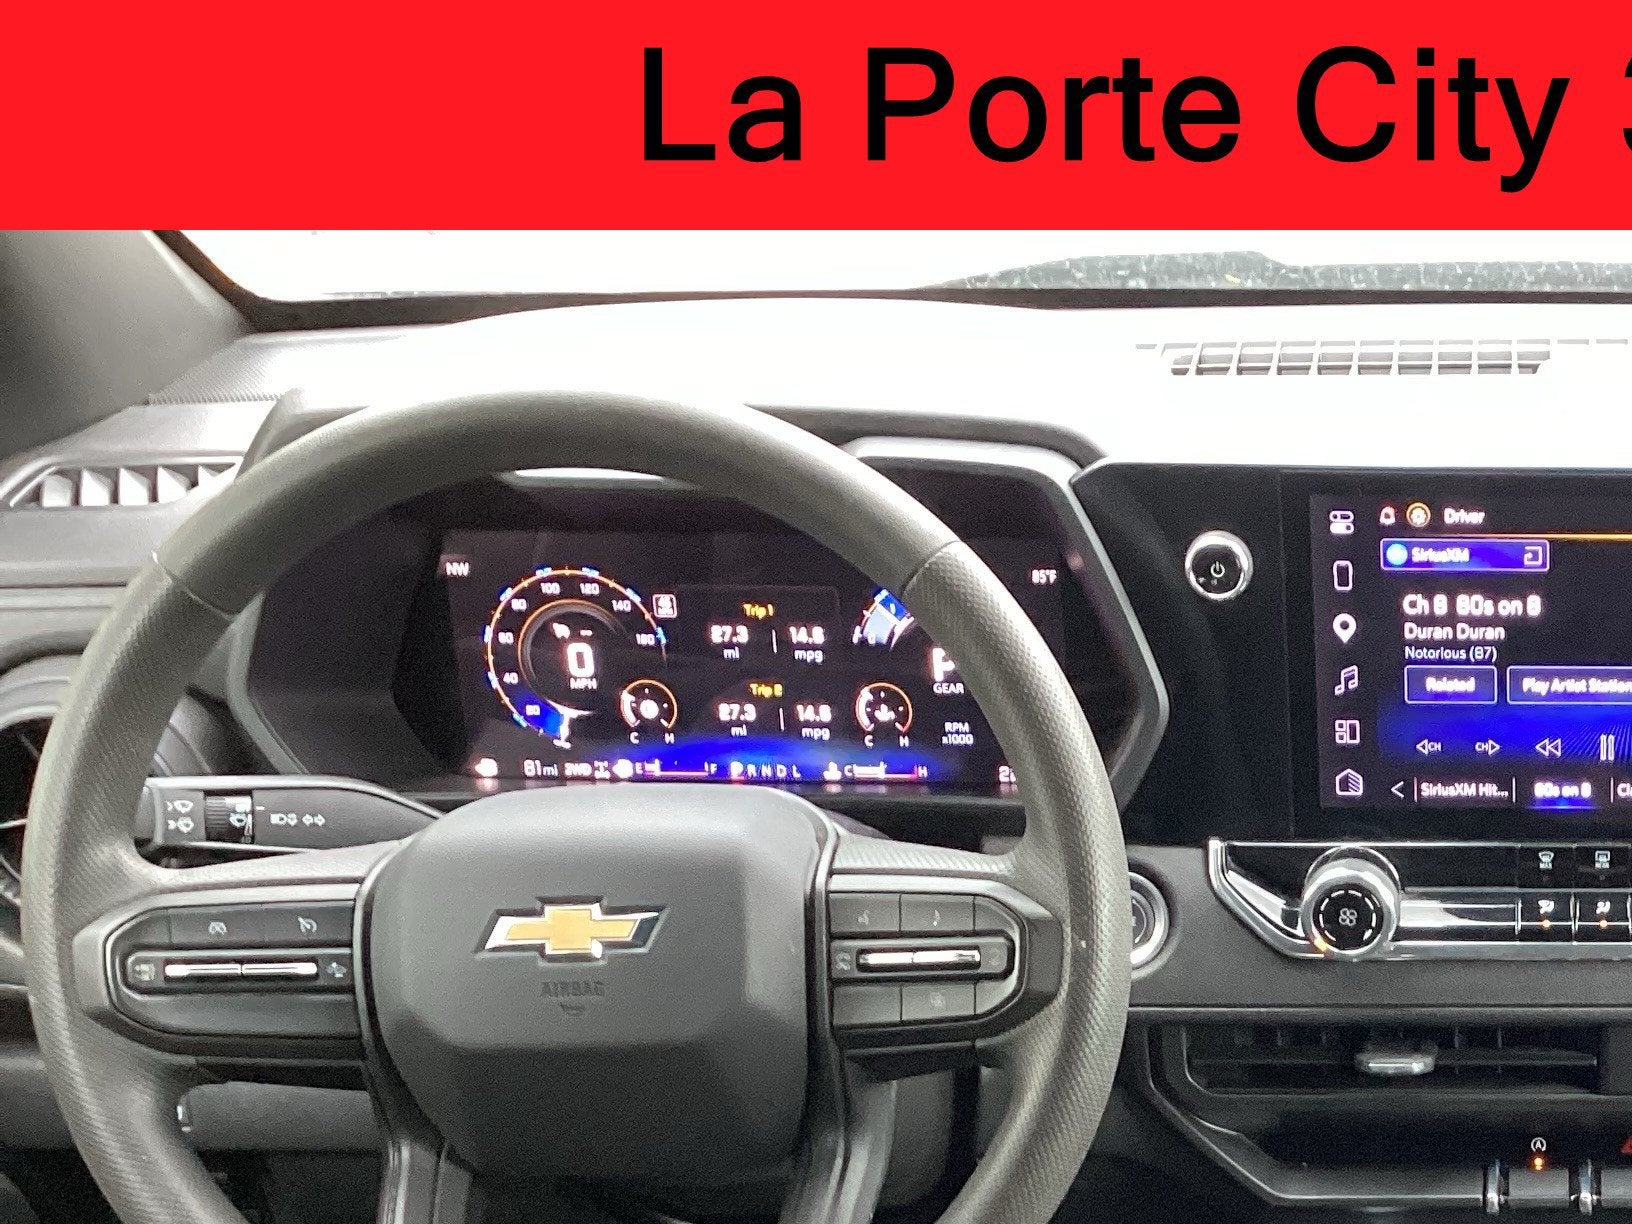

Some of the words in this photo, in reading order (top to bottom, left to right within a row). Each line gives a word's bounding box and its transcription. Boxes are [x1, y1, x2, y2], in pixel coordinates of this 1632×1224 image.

[1443, 507, 1486, 525] Driver
[446, 562, 470, 577] NW
[541, 582, 561, 595] 100
[580, 583, 600, 595] 120
[612, 599, 632, 613] 140
[1402, 594, 1430, 616] Ch
[1497, 599, 1524, 616] on
[635, 632, 655, 645] 160
[1403, 623, 1453, 641] Duran
[1456, 623, 1506, 641] Duran
[567, 641, 596, 678] 0
[793, 649, 824, 665] mpg
[1404, 646, 1467, 661] Notorious
[502, 671, 519, 685] 40
[569, 677, 598, 691] MPH
[932, 682, 965, 695] GEAR
[944, 721, 971, 734] RPM
[629, 732, 640, 745] C
[664, 732, 675, 744] H
[863, 734, 874, 748] C
[899, 735, 910, 747] H
[1420, 782, 1476, 798] SiriusXM
